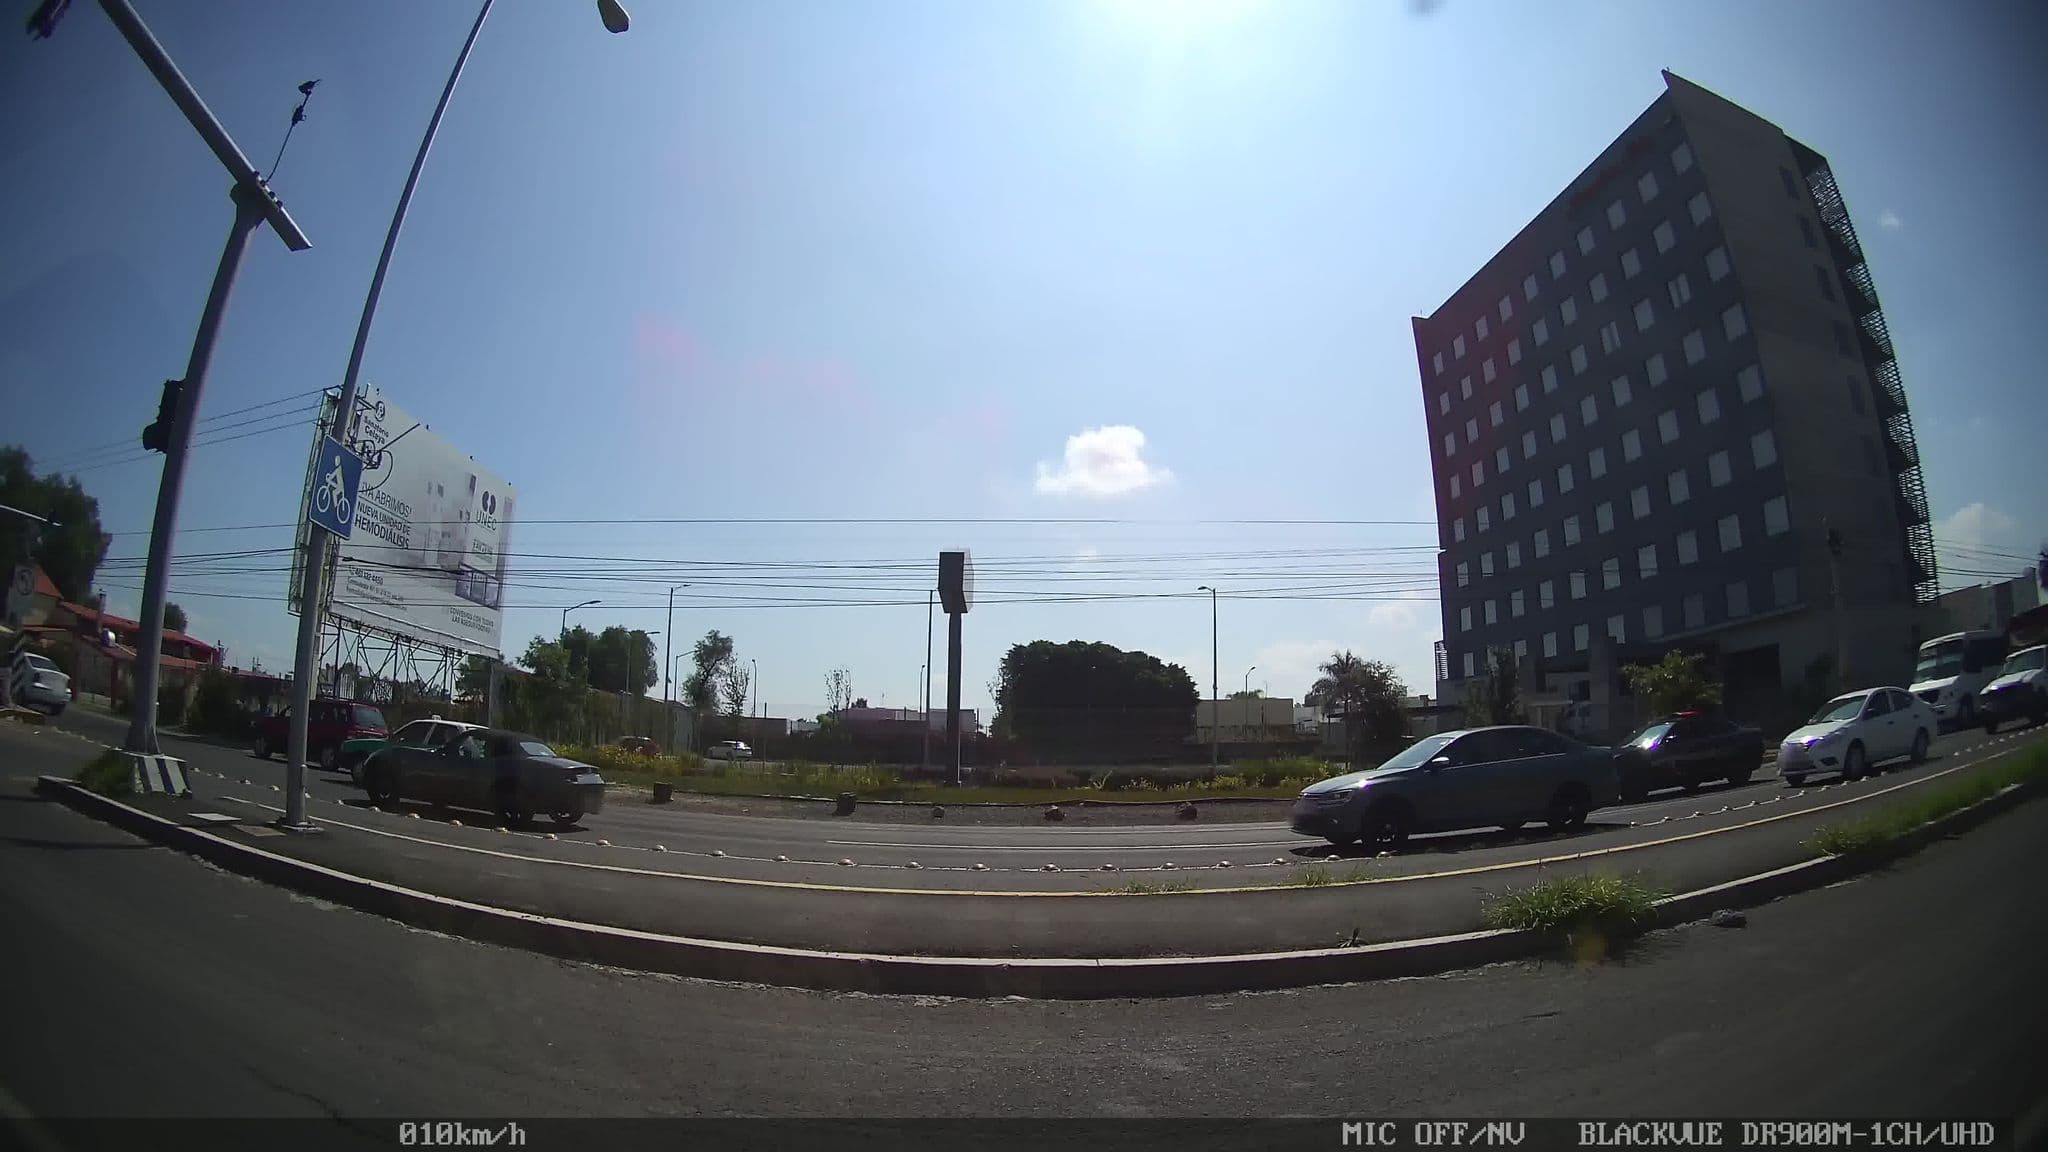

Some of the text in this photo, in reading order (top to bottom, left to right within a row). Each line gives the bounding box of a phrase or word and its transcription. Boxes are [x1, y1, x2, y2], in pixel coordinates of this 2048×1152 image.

[357, 501, 379, 521] NUEVA
[402, 522, 411, 535] DE
[476, 511, 497, 531] UNEC
